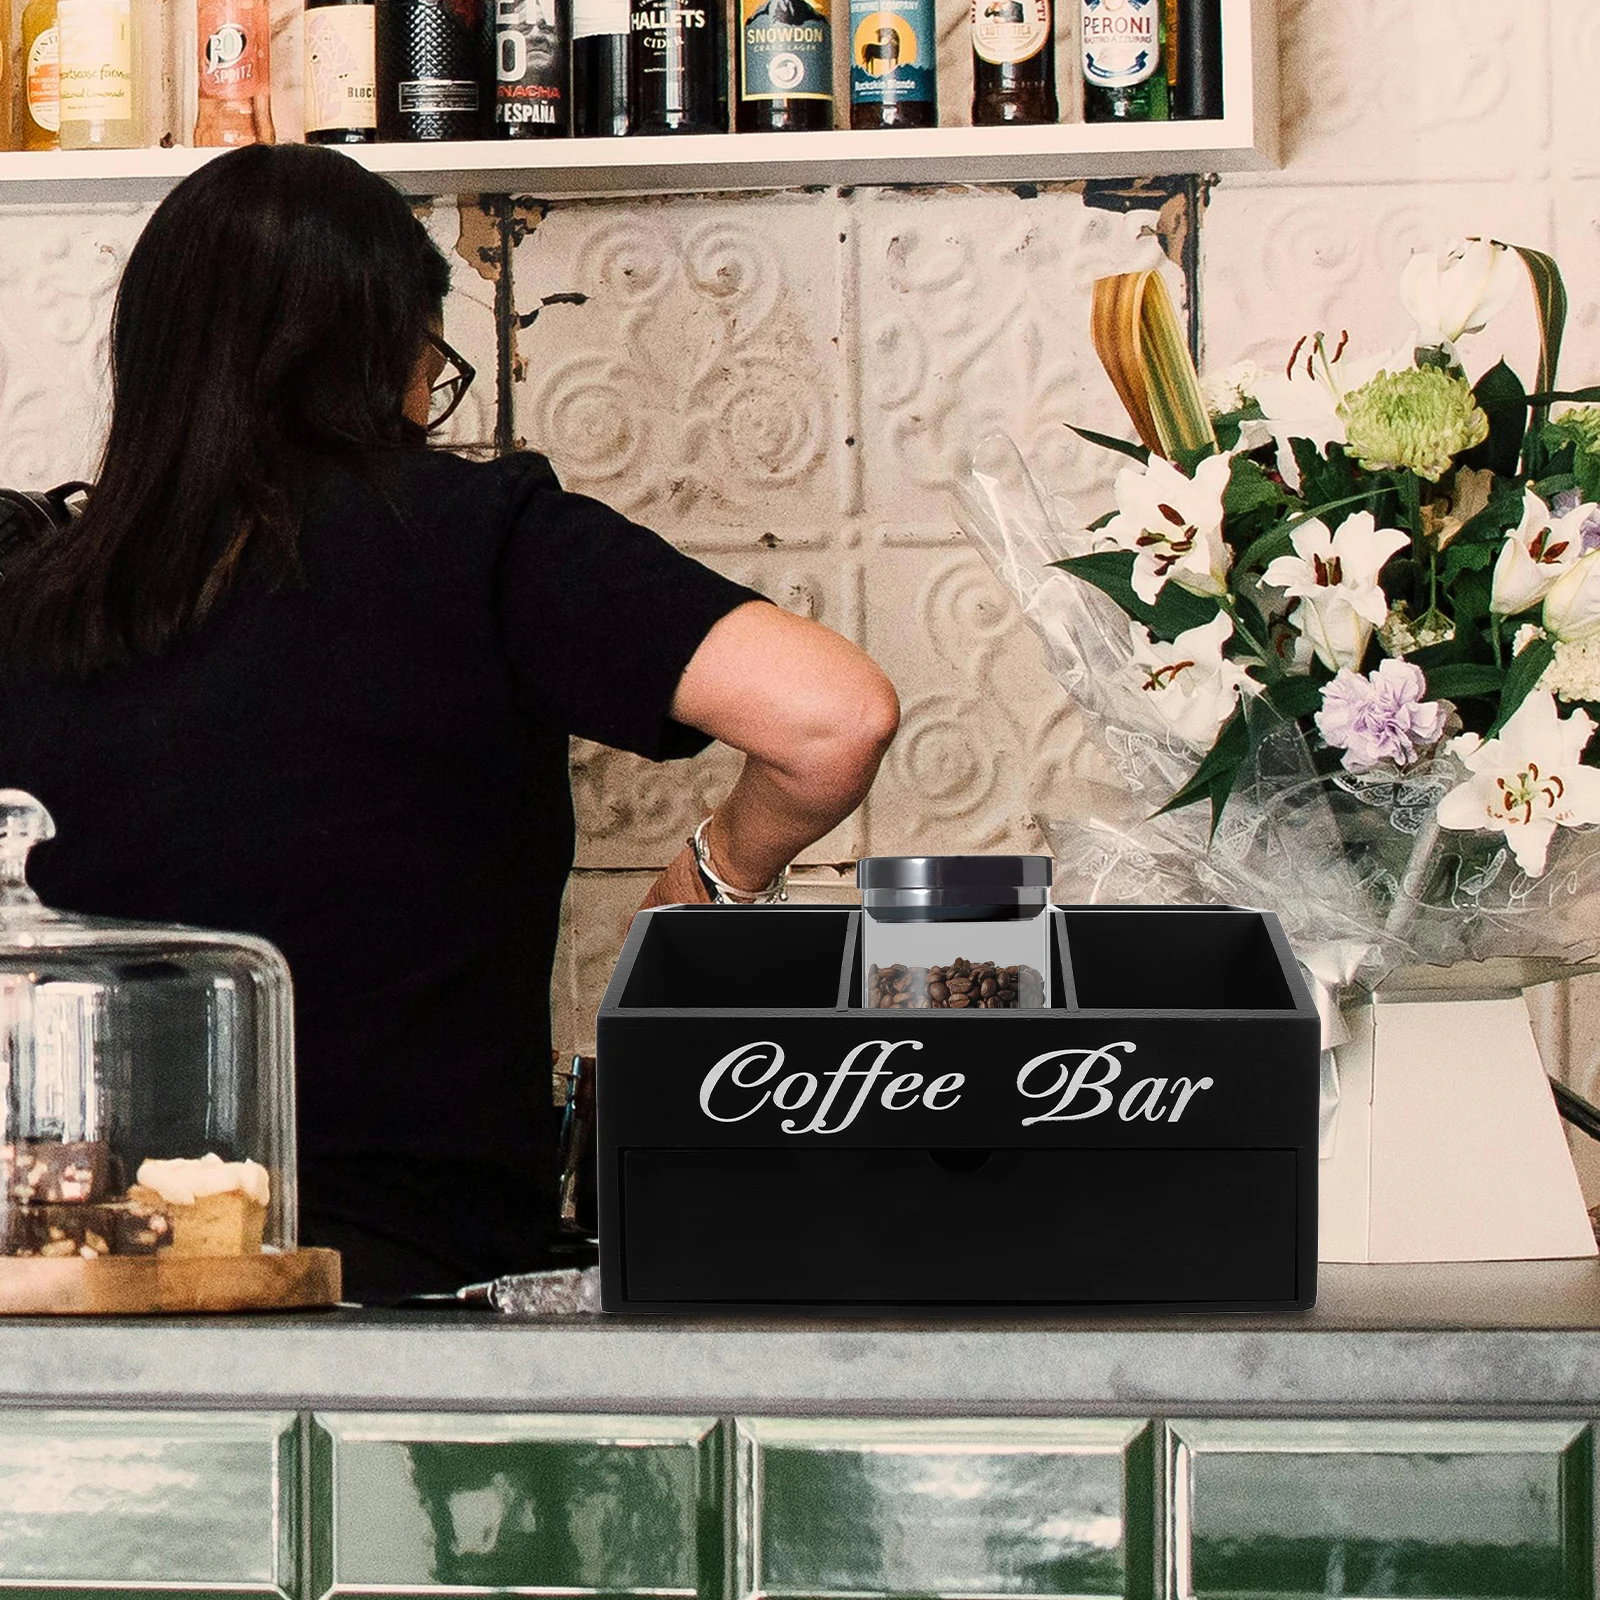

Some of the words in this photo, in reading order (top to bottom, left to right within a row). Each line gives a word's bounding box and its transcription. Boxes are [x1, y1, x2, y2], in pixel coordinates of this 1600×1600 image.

[631, 10, 706, 31] HALLETS
[1084, 16, 1150, 35] PERONI
[747, 28, 823, 44] SNOWDON
[213, 61, 253, 85] SPRITZ
[504, 100, 556, 124] ESPAÑA
[700, 1040, 965, 1134] Coffee
[1017, 1042, 1213, 1126] Bar
